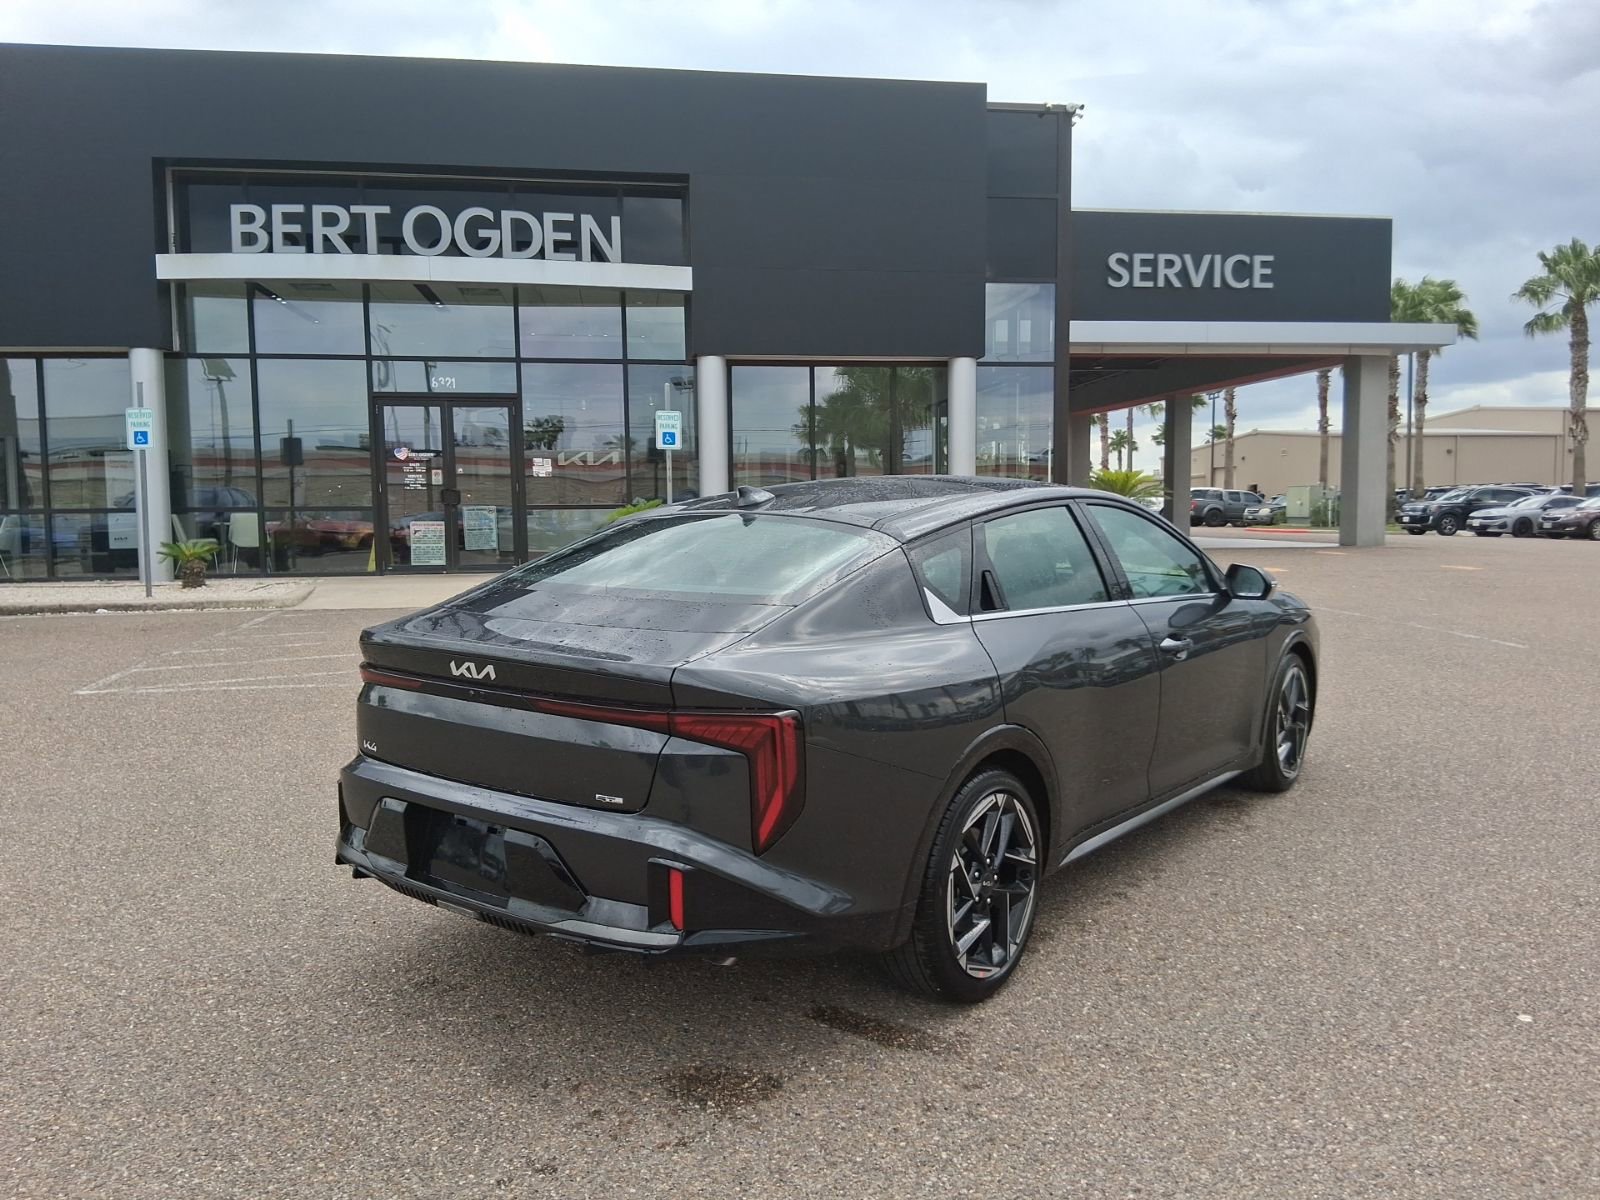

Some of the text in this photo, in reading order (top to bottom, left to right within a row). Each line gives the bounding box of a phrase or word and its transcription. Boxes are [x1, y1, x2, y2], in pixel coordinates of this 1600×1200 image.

[230, 203, 622, 263] BERT OGDEN
[1107, 252, 1275, 289] SERVICE
[128, 411, 152, 419] RESERVED
[557, 451, 621, 466] KIA
[449, 660, 496, 680] KIA
[363, 739, 377, 752] K4
